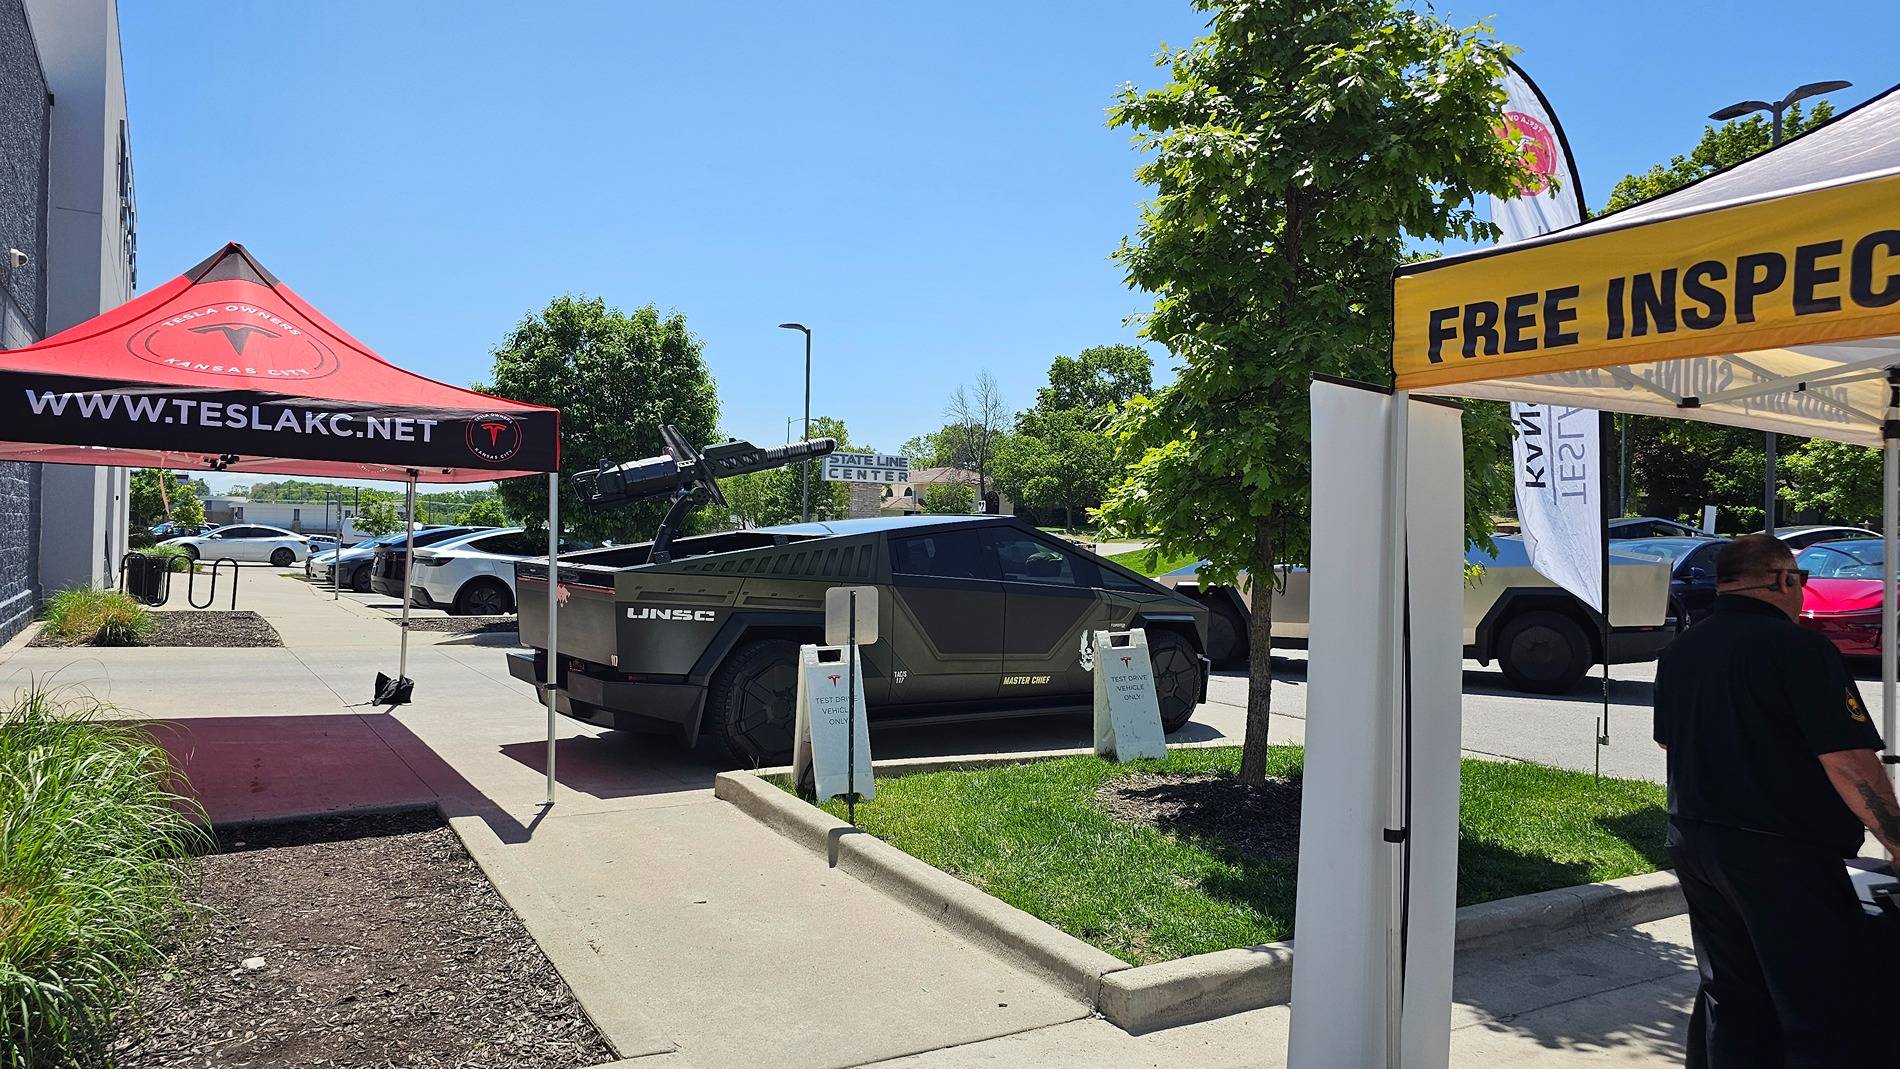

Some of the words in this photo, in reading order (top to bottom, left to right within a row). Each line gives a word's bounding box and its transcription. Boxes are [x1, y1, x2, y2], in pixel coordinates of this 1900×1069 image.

[1428, 285, 1580, 364] FREE
[1606, 229, 1900, 341] INSPEC
[161, 308, 219, 328] TESLA
[225, 305, 303, 337] OWNERS
[164, 357, 258, 375] KANSAS
[268, 368, 311, 378] CITY
[25, 388, 439, 443] WWW.TESLAKC.NET
[474, 447, 499, 460] KANSAS
[829, 453, 874, 466] STATE
[876, 456, 909, 468] LINE
[828, 468, 908, 482] CENTER
[626, 607, 716, 622] UNSC
[1003, 676, 1031, 685] MASTER
[1031, 675, 1051, 684] CHIEF
[822, 707, 849, 715] VEHICL
[829, 718, 849, 726] ONLY
